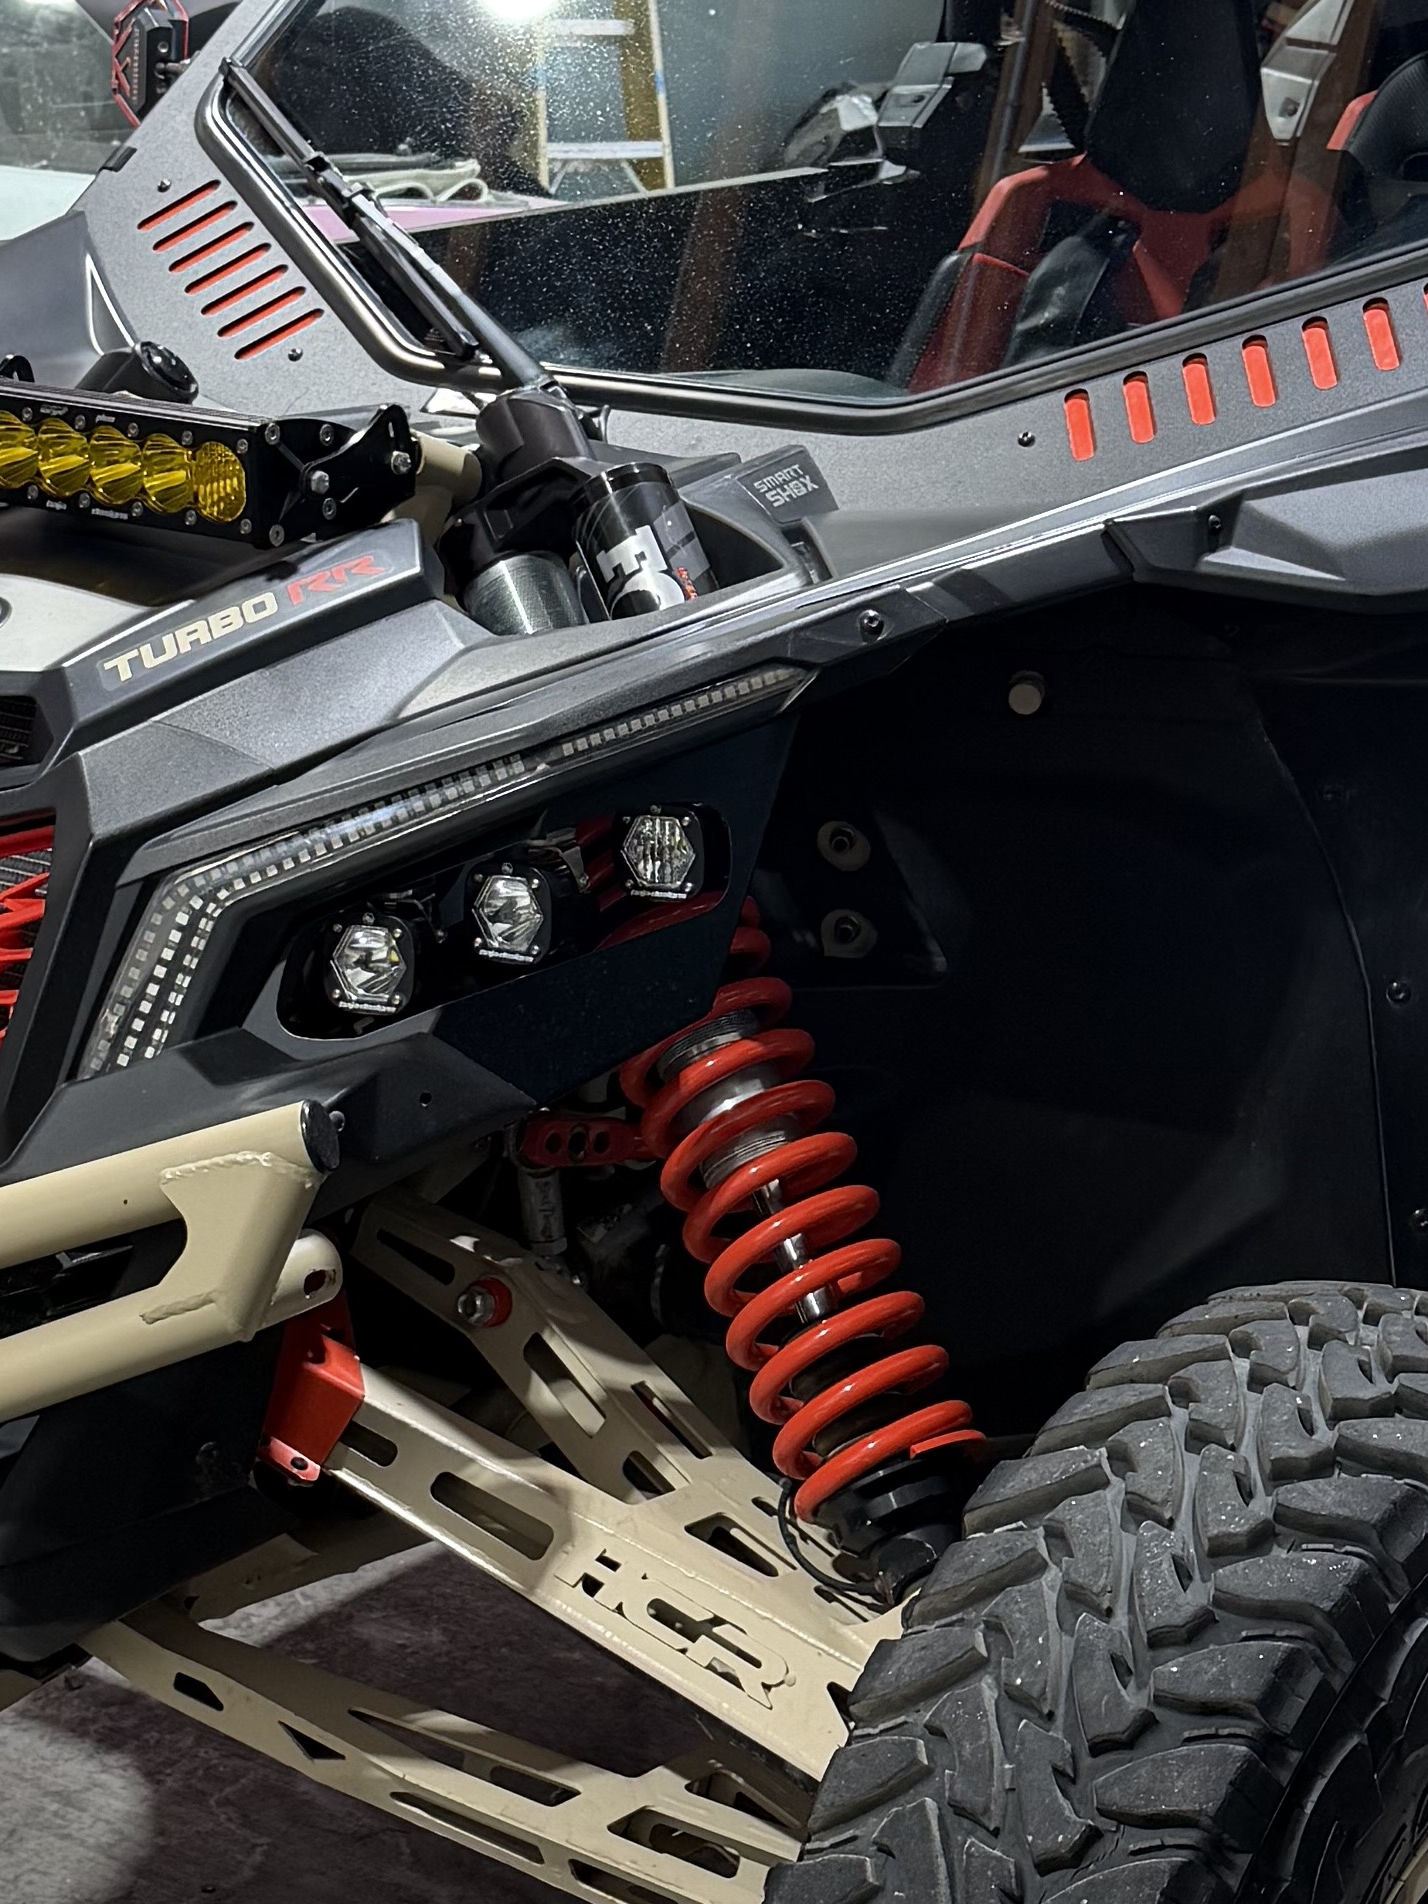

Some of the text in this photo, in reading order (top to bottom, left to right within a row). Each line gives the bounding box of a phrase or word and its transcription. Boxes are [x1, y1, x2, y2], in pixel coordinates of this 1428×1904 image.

[753, 463, 805, 494] SMART
[103, 555, 385, 682] TURBO RR
